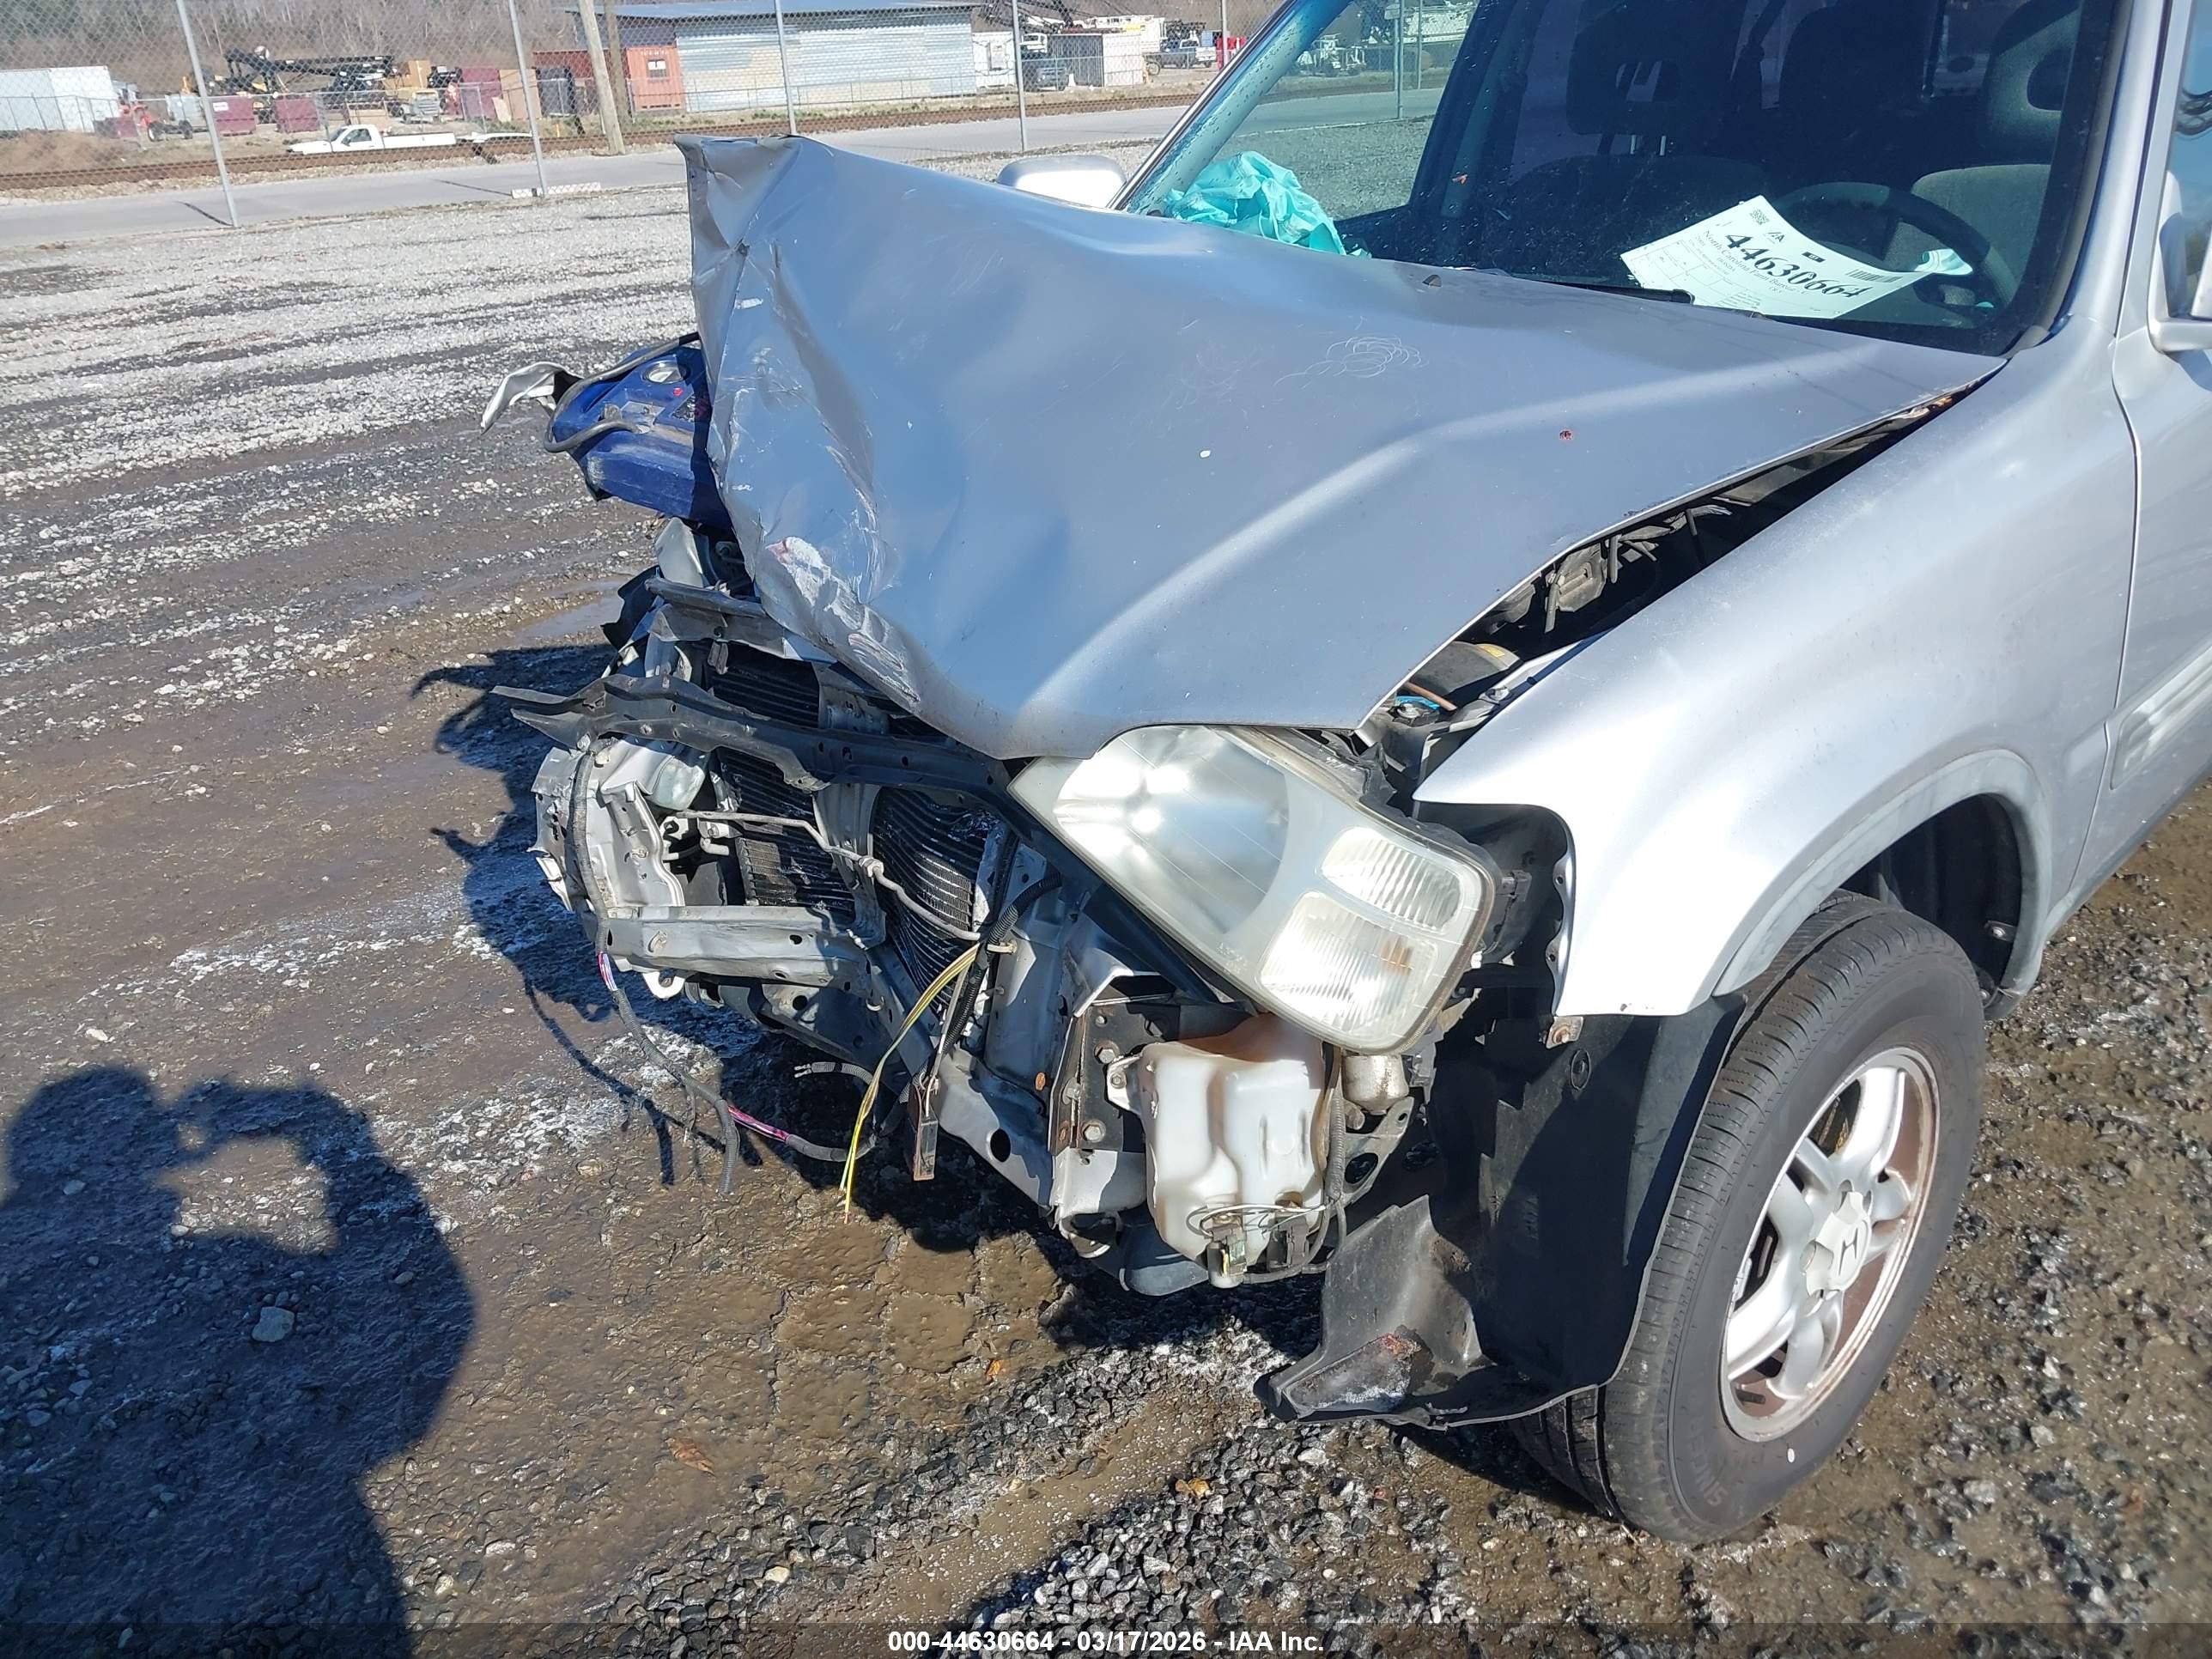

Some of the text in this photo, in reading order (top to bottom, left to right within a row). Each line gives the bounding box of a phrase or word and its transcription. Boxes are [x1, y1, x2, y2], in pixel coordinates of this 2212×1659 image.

[1703, 229, 1723, 251] North
[1721, 248, 1751, 272] Carolina
[1749, 269, 1770, 282] Farm
[1725, 234, 1874, 298] 44630664
[1684, 1388, 1729, 1508] SINCER
